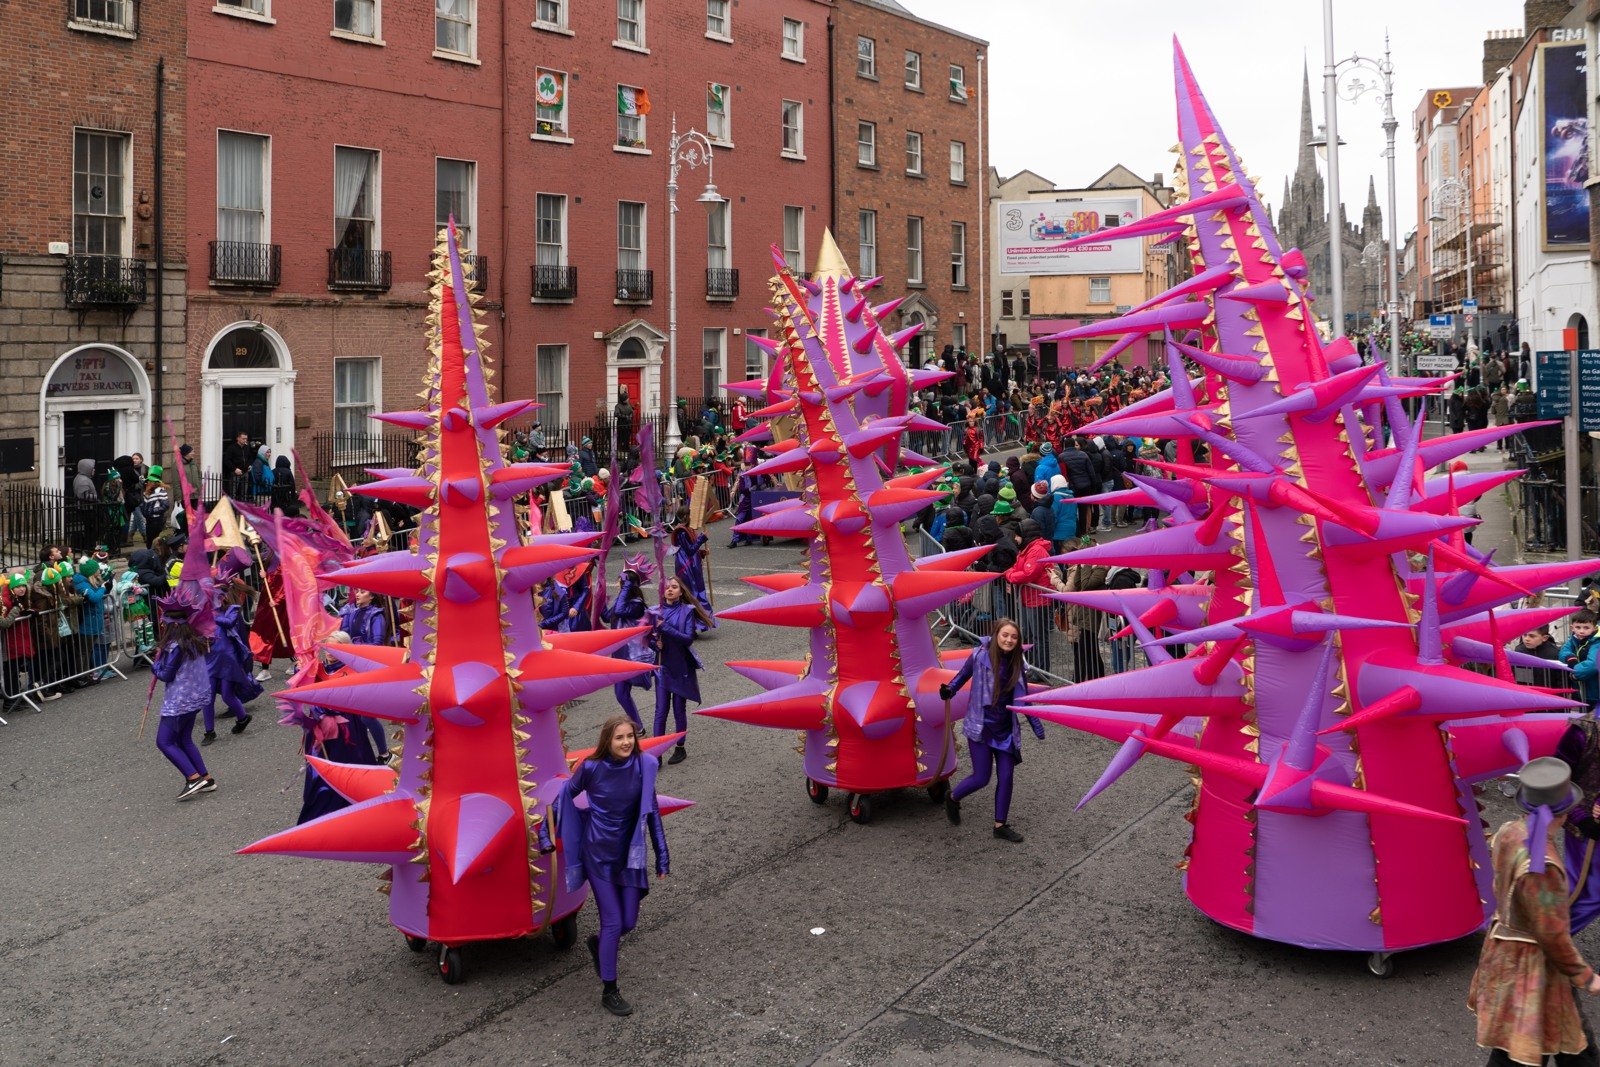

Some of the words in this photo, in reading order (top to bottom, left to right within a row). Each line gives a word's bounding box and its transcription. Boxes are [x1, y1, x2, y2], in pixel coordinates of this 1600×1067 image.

[1006, 209, 1024, 231] 3
[235, 347, 248, 356] 29
[80, 372, 102, 381] TAXI
[47, 382, 90, 392] DRIVERS
[93, 381, 132, 390] BRANCH
